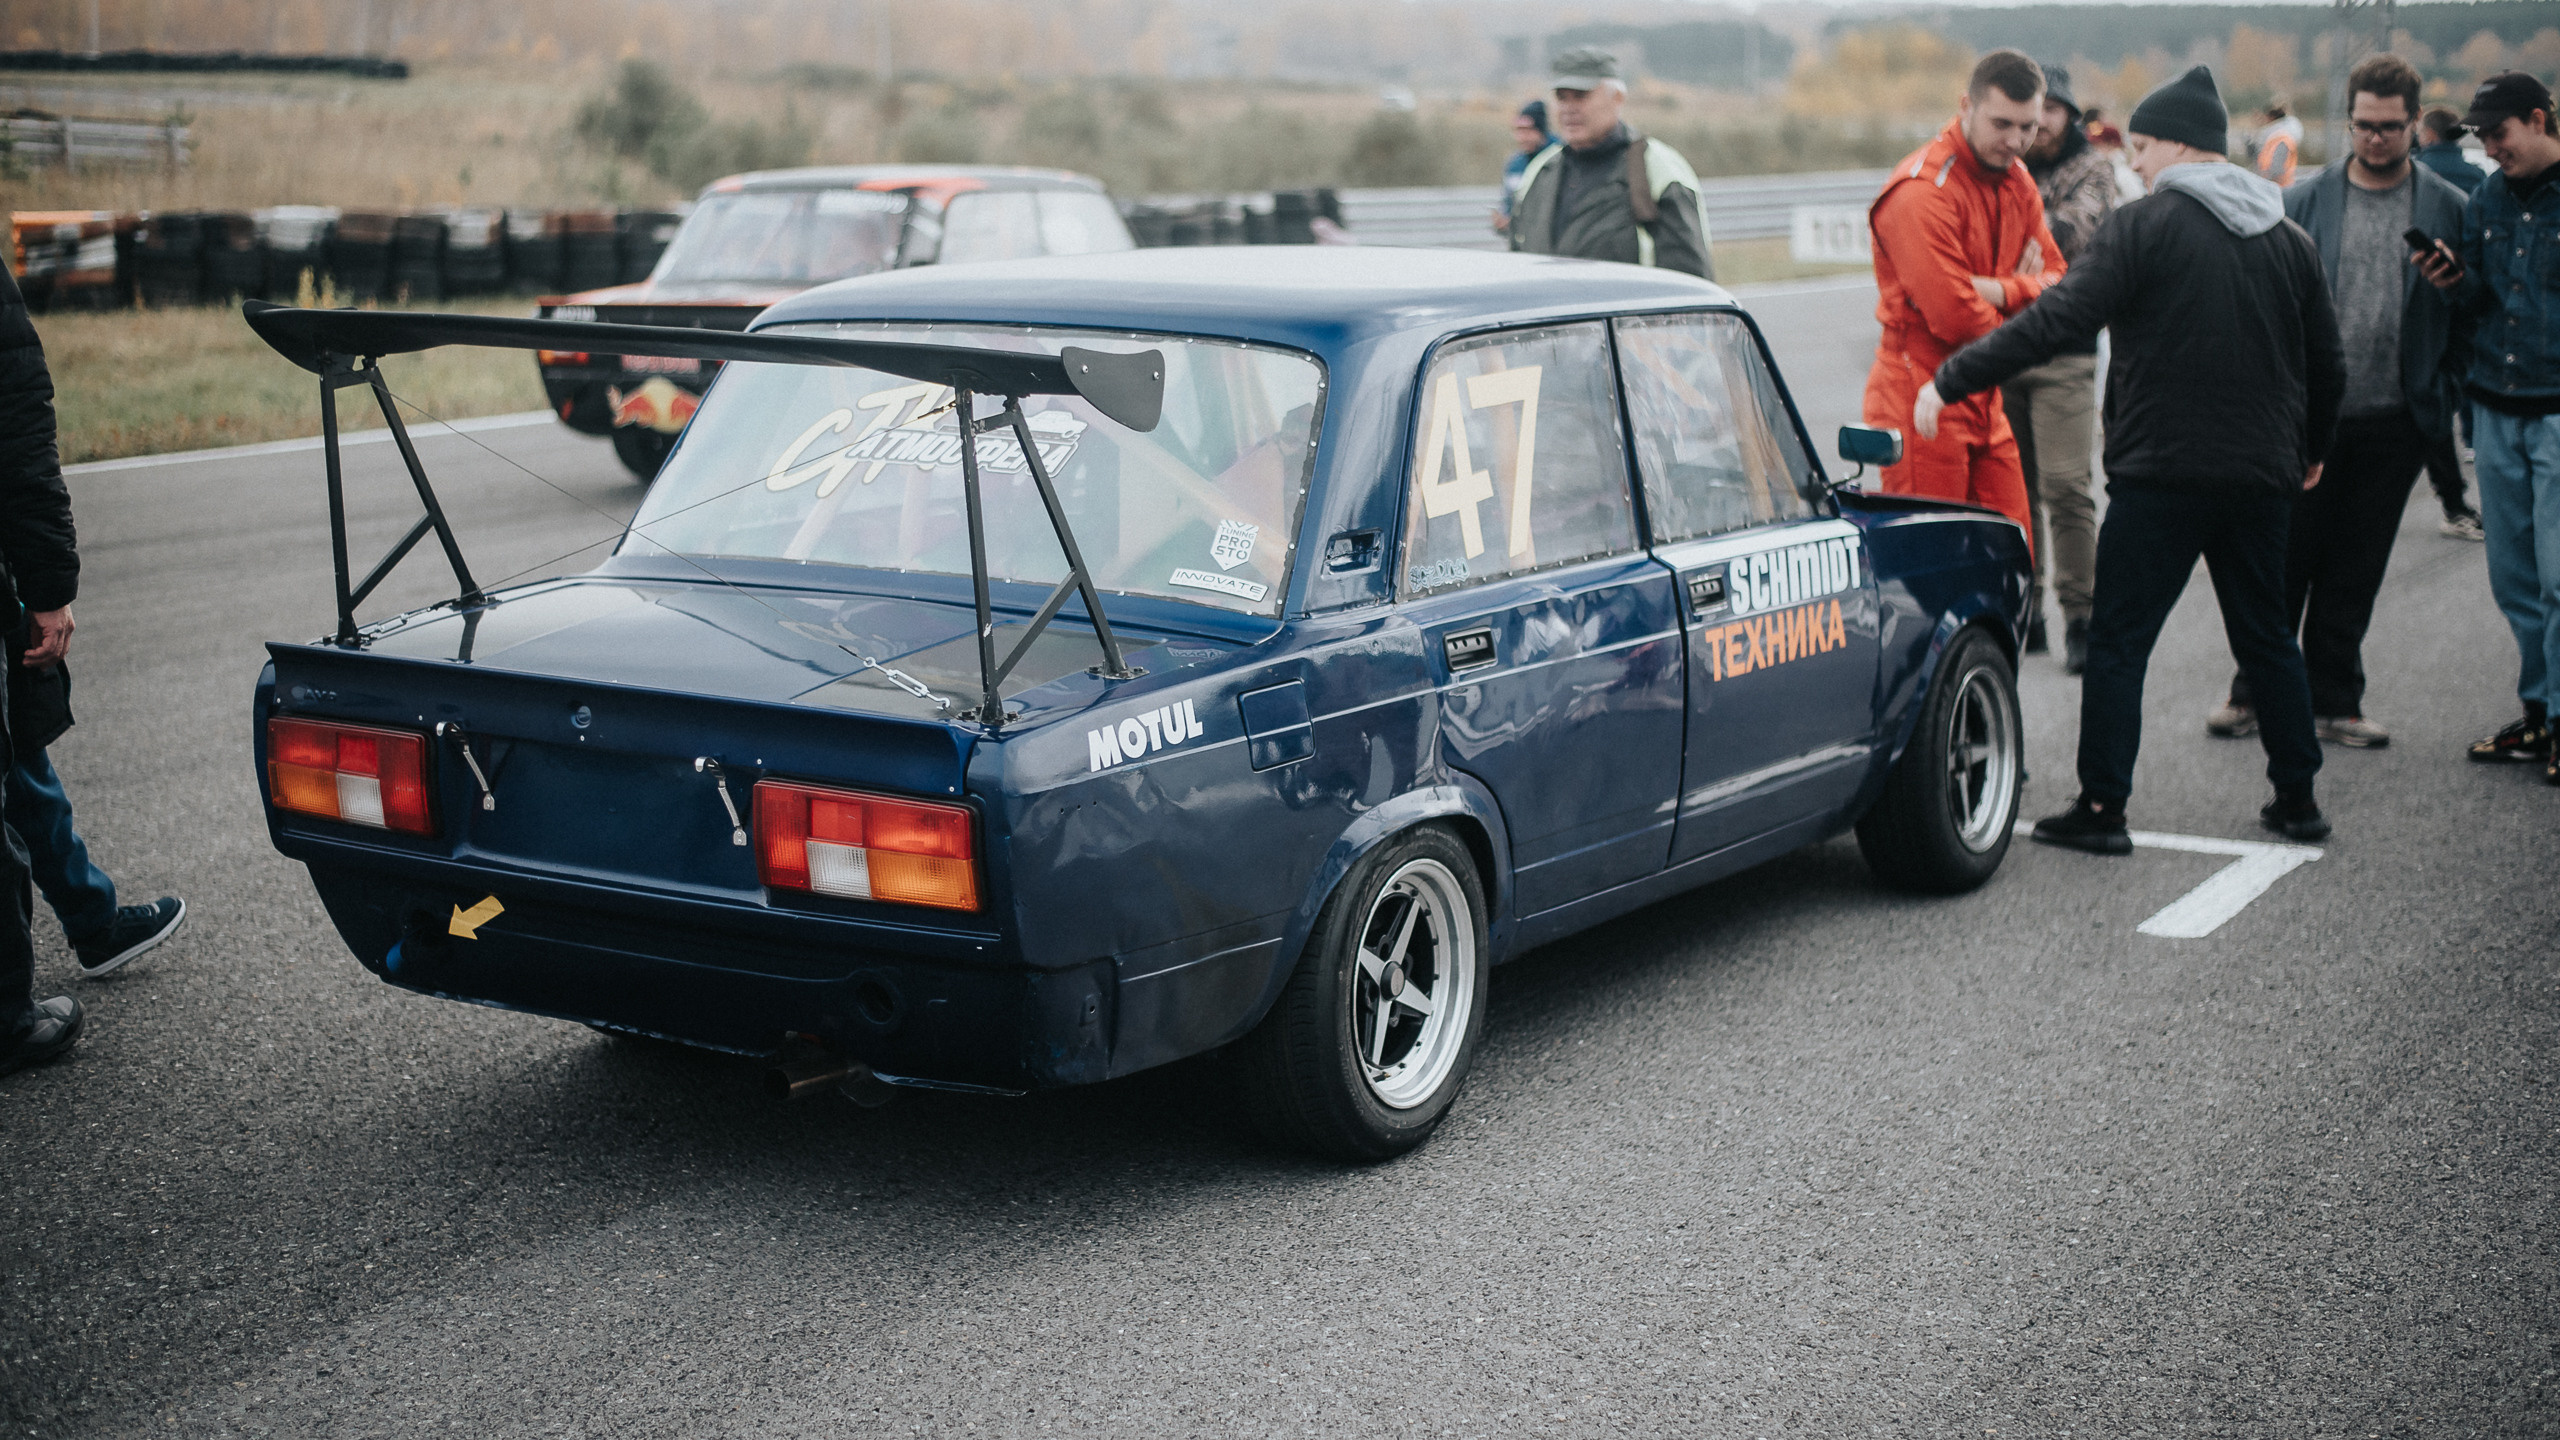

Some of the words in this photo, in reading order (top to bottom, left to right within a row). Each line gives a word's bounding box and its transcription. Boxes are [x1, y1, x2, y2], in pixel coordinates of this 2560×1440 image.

[1421, 365, 1543, 560] 47
[1214, 545, 1248, 561] STO
[1218, 534, 1251, 550] PRO
[1221, 526, 1255, 540] TUNING
[1176, 571, 1263, 595] INNOVATE
[1729, 535, 1861, 616] SCHMIDT
[1705, 598, 1847, 683] ТЕХНИКА
[1088, 698, 1203, 773] MOTUL
